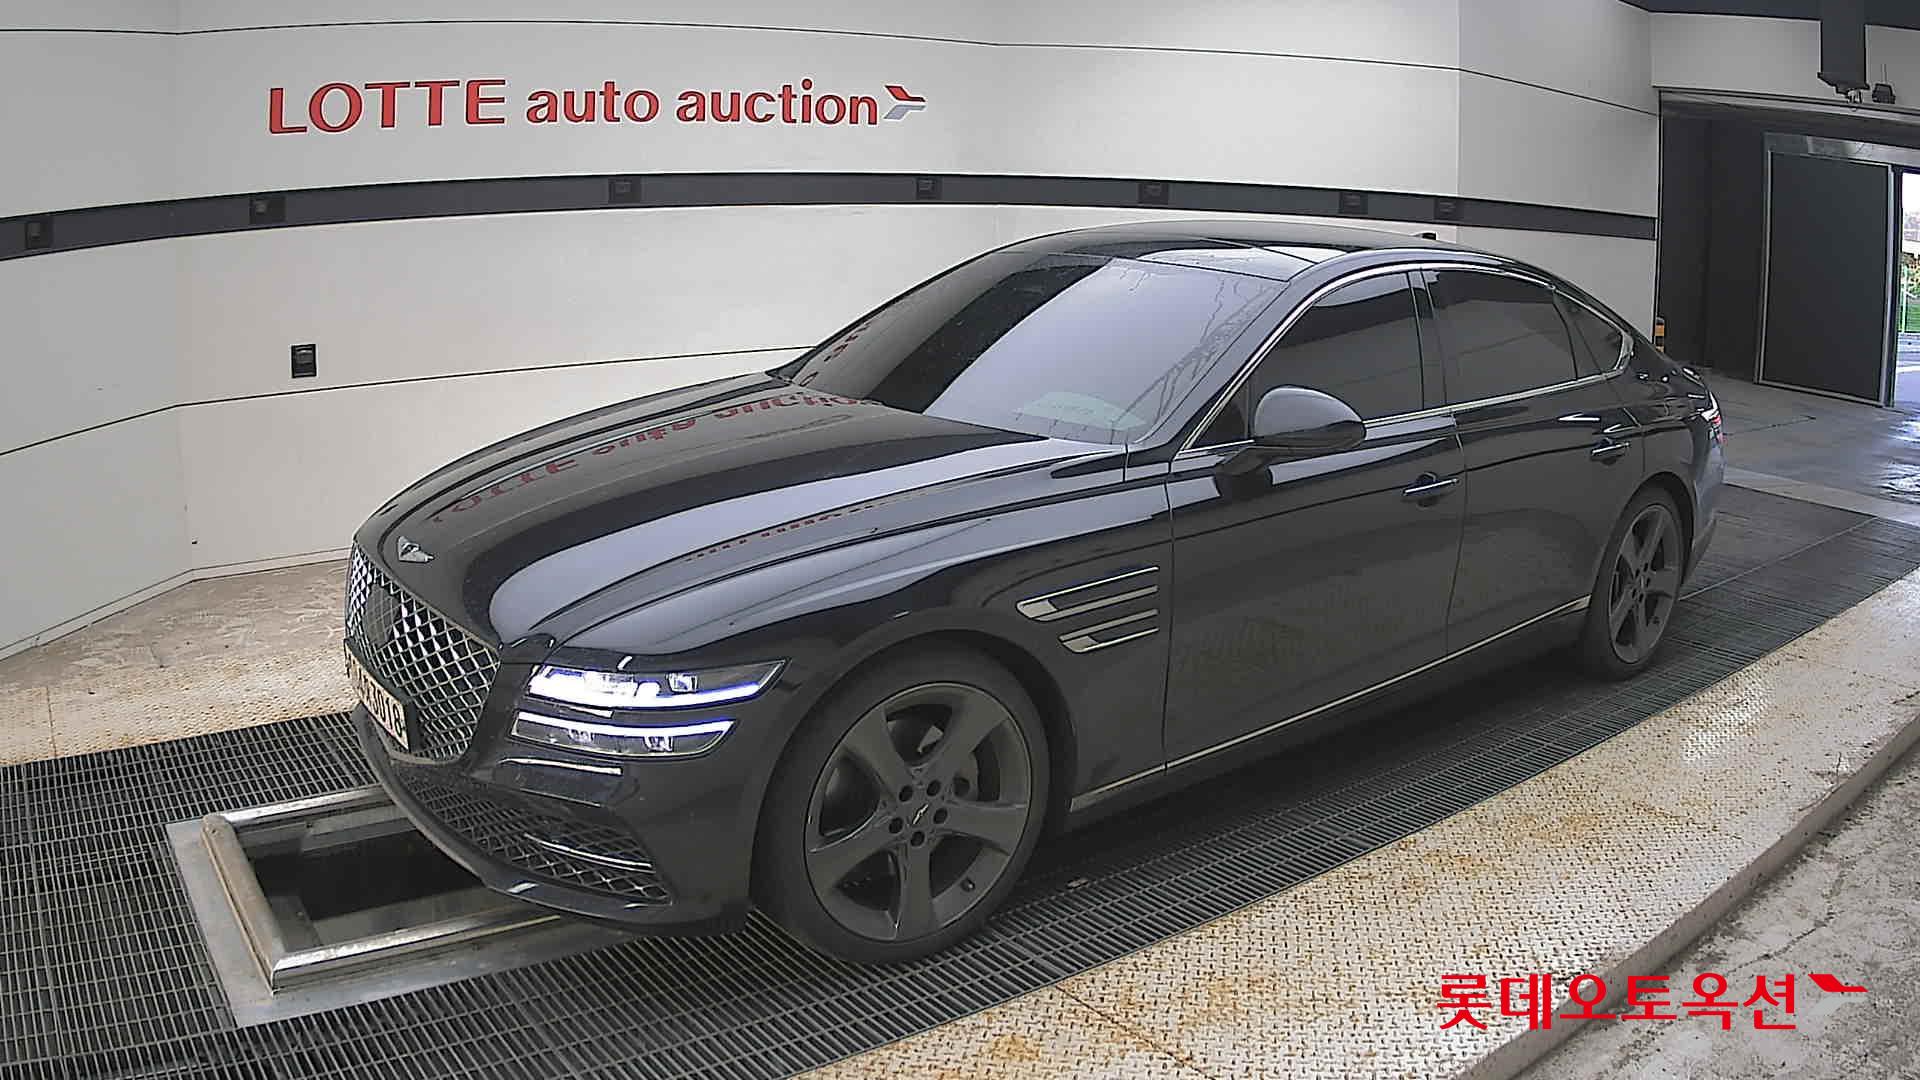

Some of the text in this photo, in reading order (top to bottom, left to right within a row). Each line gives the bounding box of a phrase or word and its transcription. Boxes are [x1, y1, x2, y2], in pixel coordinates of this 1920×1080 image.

[268, 78, 879, 134] LOTTE auto auction
